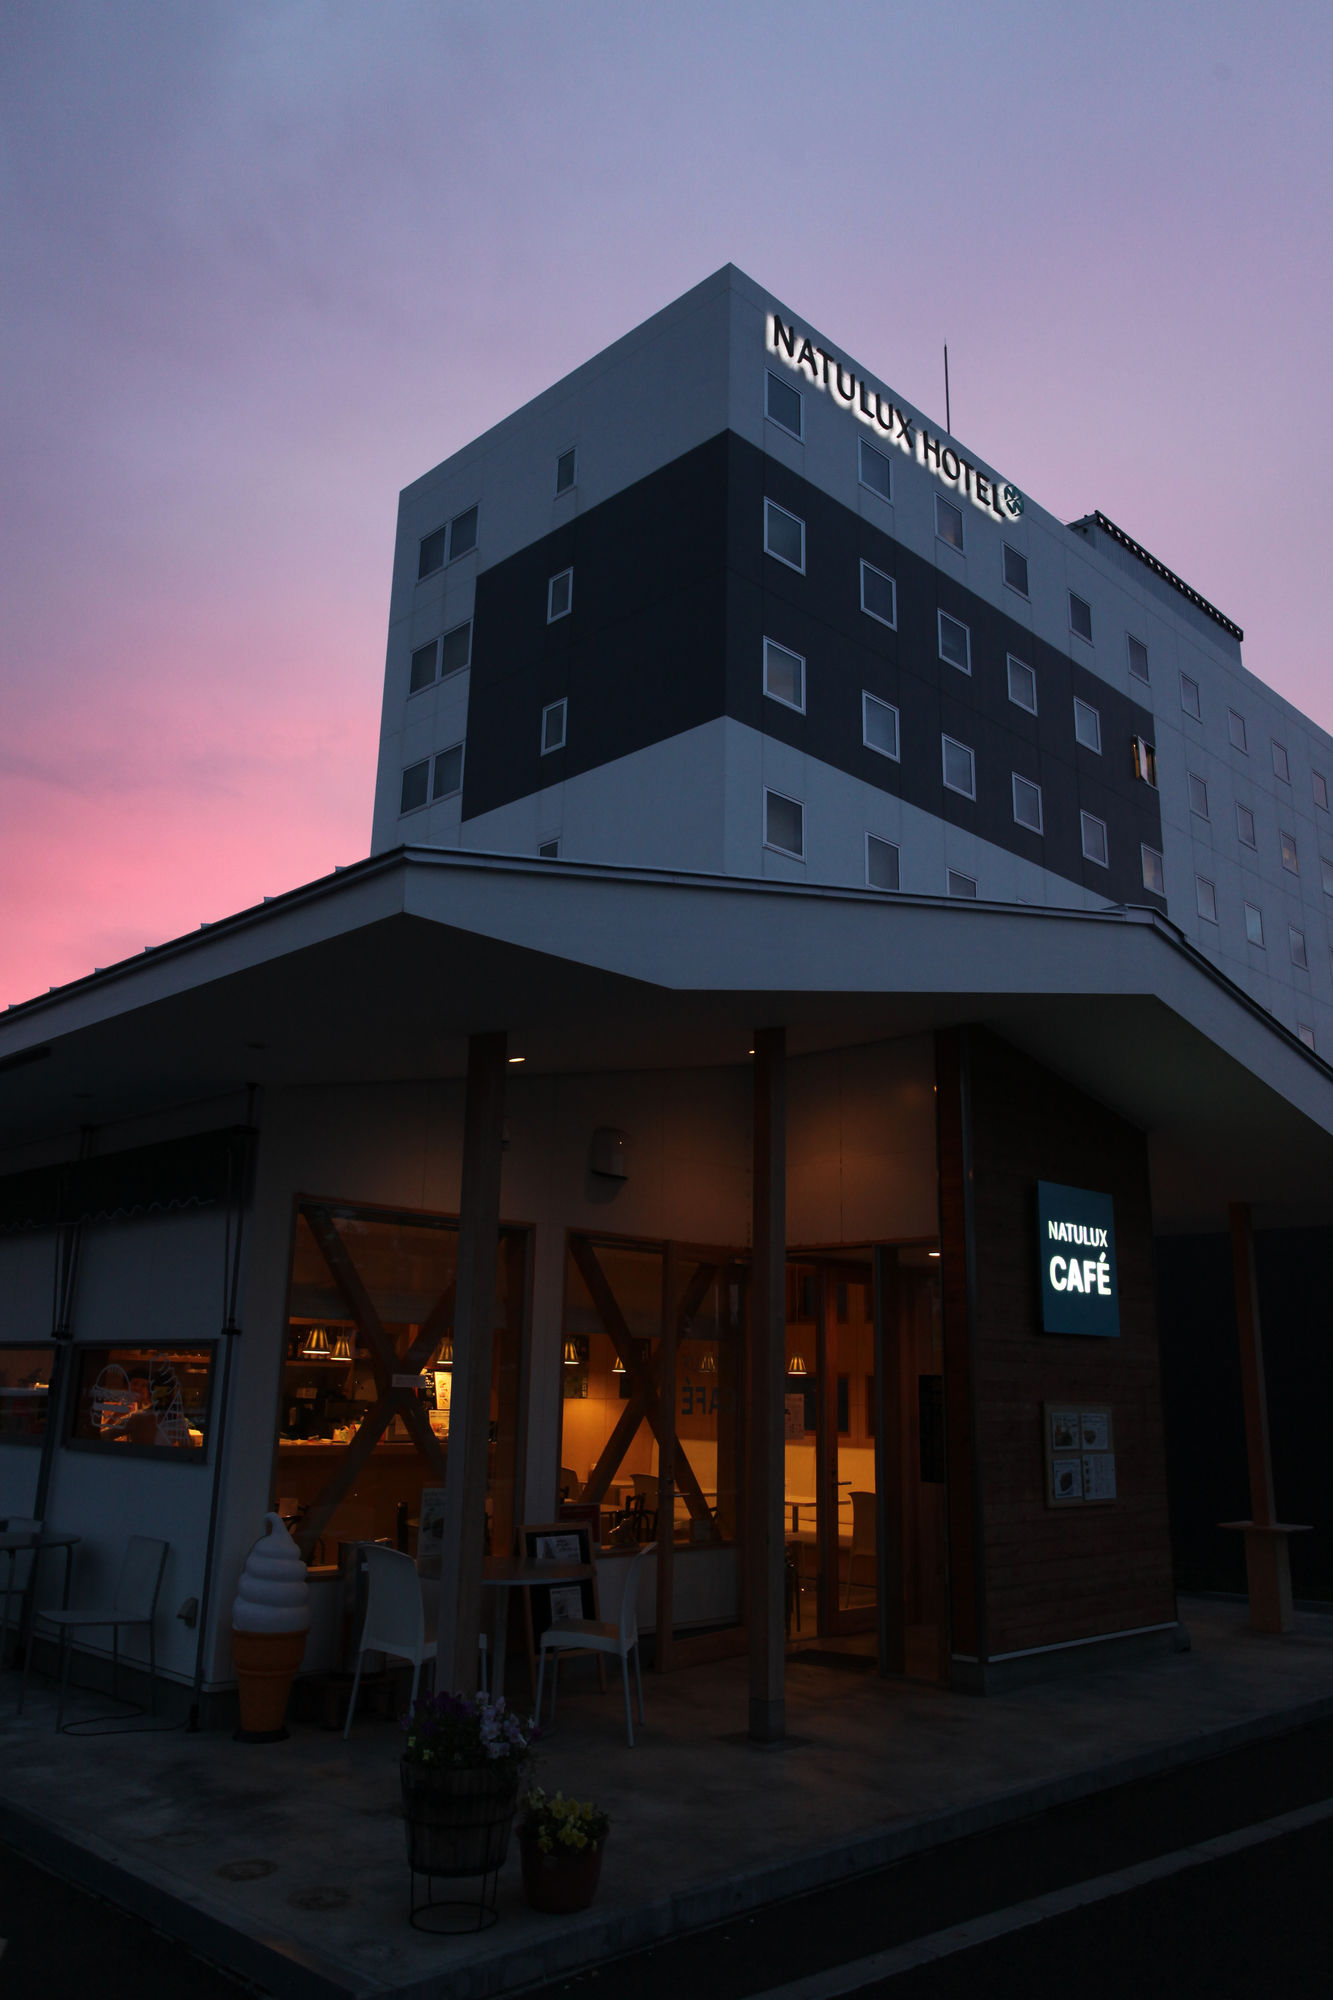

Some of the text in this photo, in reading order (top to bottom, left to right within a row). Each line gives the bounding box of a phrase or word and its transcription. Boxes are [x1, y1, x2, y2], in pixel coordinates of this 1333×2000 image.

[773, 314, 1006, 518] NATULUX HOTEL
[1048, 1220, 1109, 1248] NATULUX
[1049, 1251, 1112, 1296] CAFÉ
